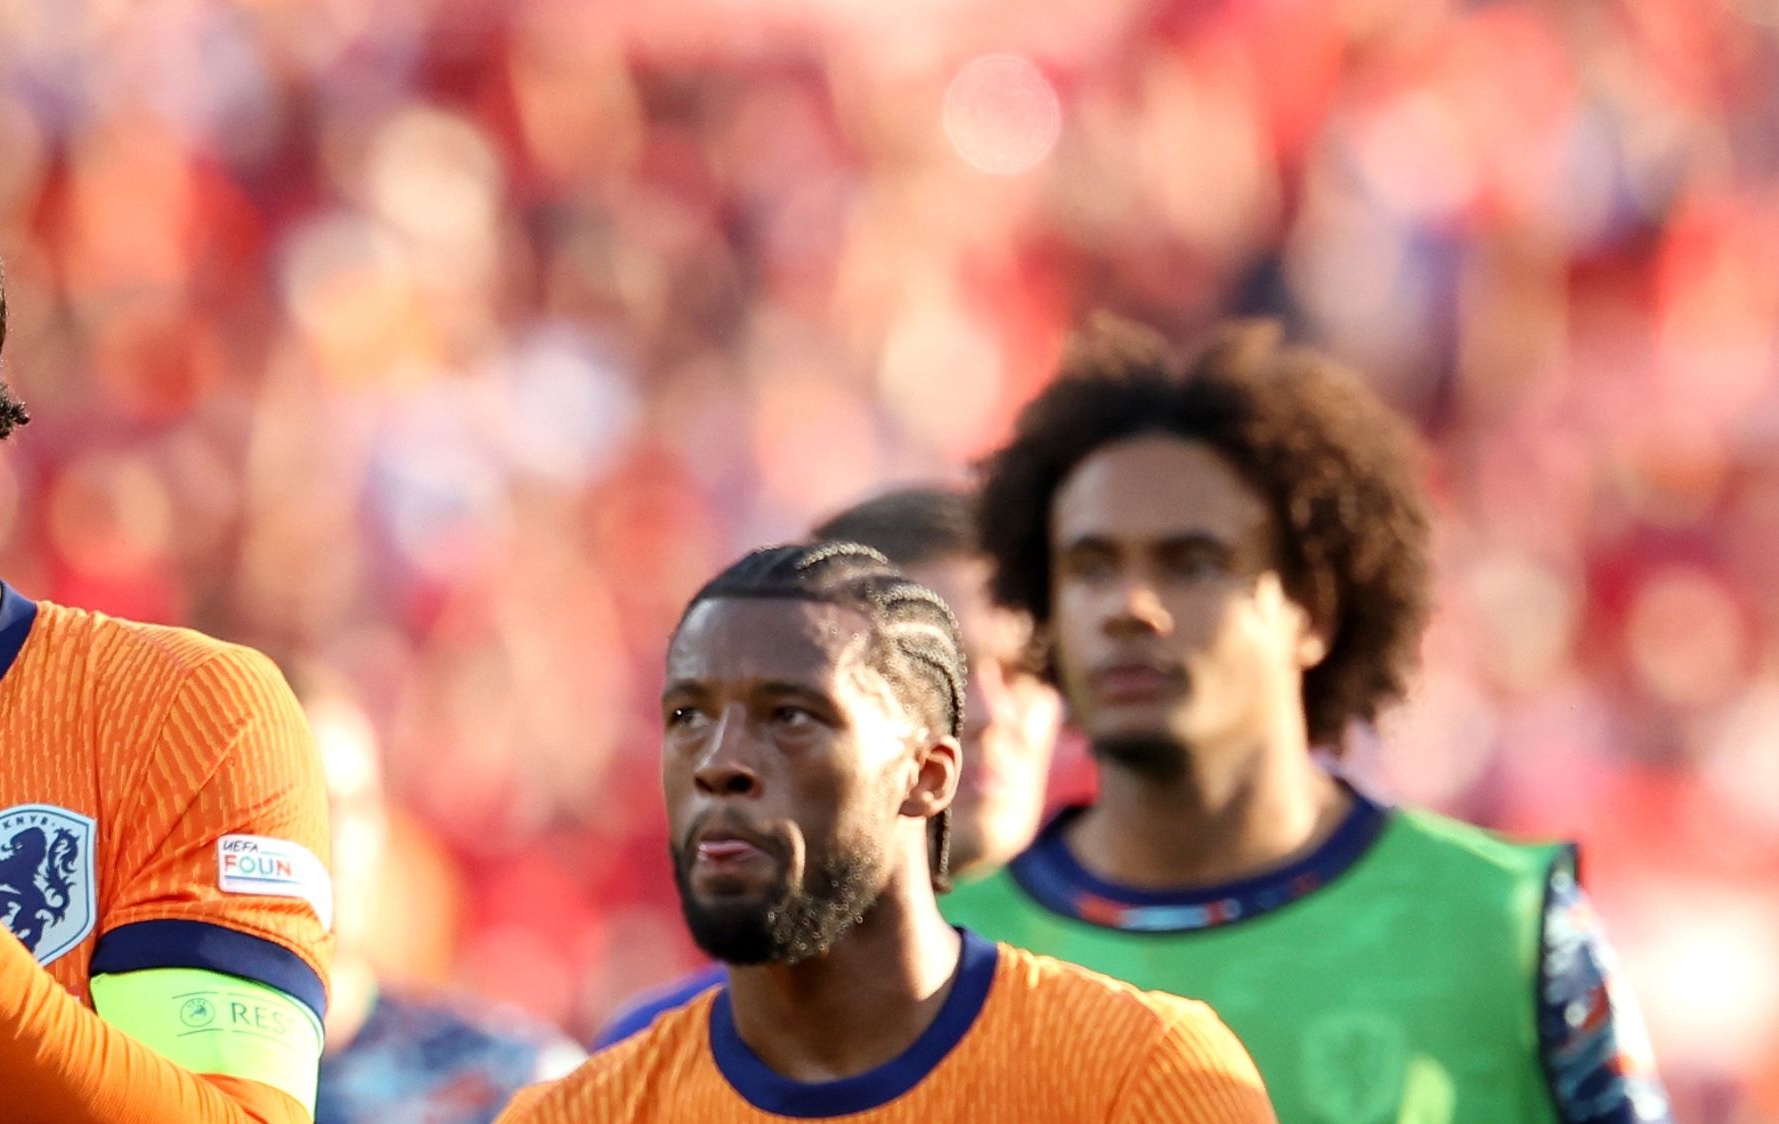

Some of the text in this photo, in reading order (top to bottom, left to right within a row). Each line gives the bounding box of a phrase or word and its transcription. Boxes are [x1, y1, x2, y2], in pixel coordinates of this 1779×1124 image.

[223, 839, 258, 853] UEFA
[224, 854, 292, 877] FOUN
[231, 1002, 287, 1035] RES
